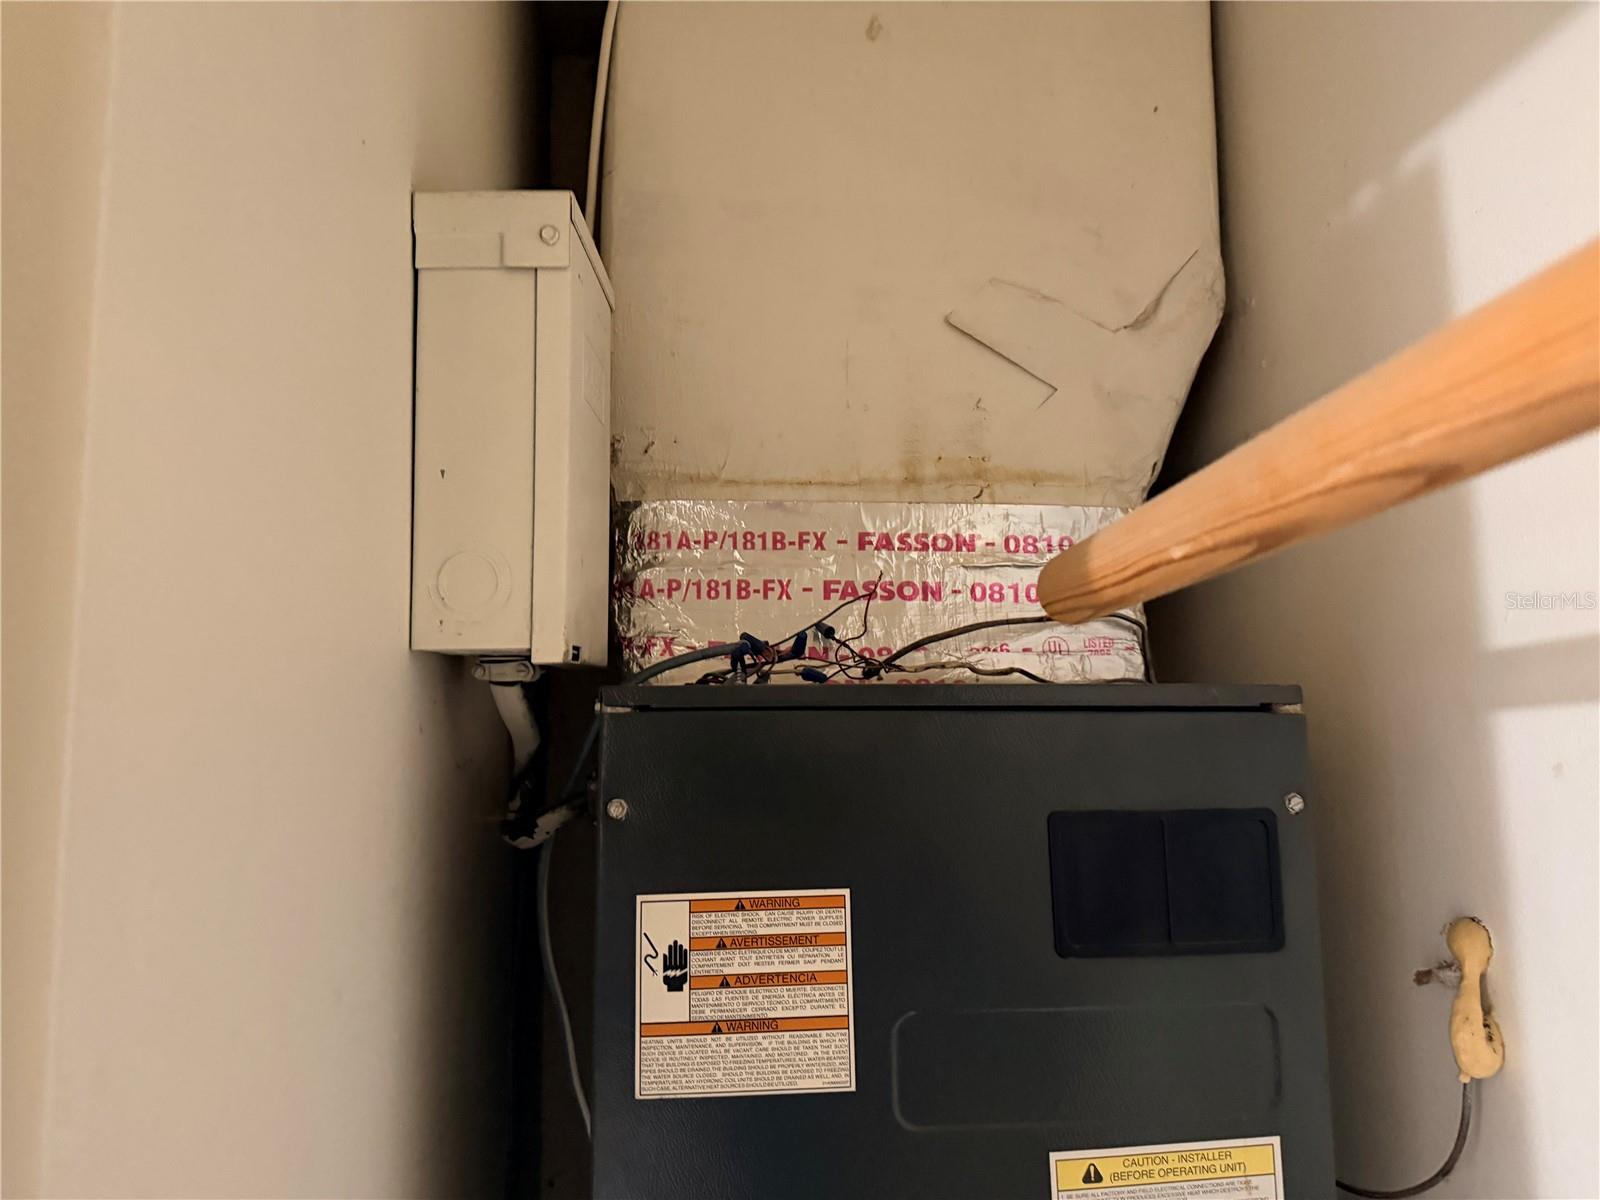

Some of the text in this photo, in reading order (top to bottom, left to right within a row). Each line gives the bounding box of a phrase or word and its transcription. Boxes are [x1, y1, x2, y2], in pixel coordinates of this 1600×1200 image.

[858, 532, 976, 552] FASSON
[613, 578, 793, 602] A-P/181B-FX
[822, 579, 943, 601] FASSON
[749, 898, 800, 909] WARNING
[730, 935, 819, 947] AVERTISSEMENT
[734, 972, 818, 986] ADVERTENCIA
[726, 1020, 778, 1032] WARNING
[1122, 1155, 1169, 1169] CAUTION
[1177, 1150, 1232, 1163] INSTALLER
[1110, 1161, 1247, 1184] (BEFORE OPERATING UNIT)
